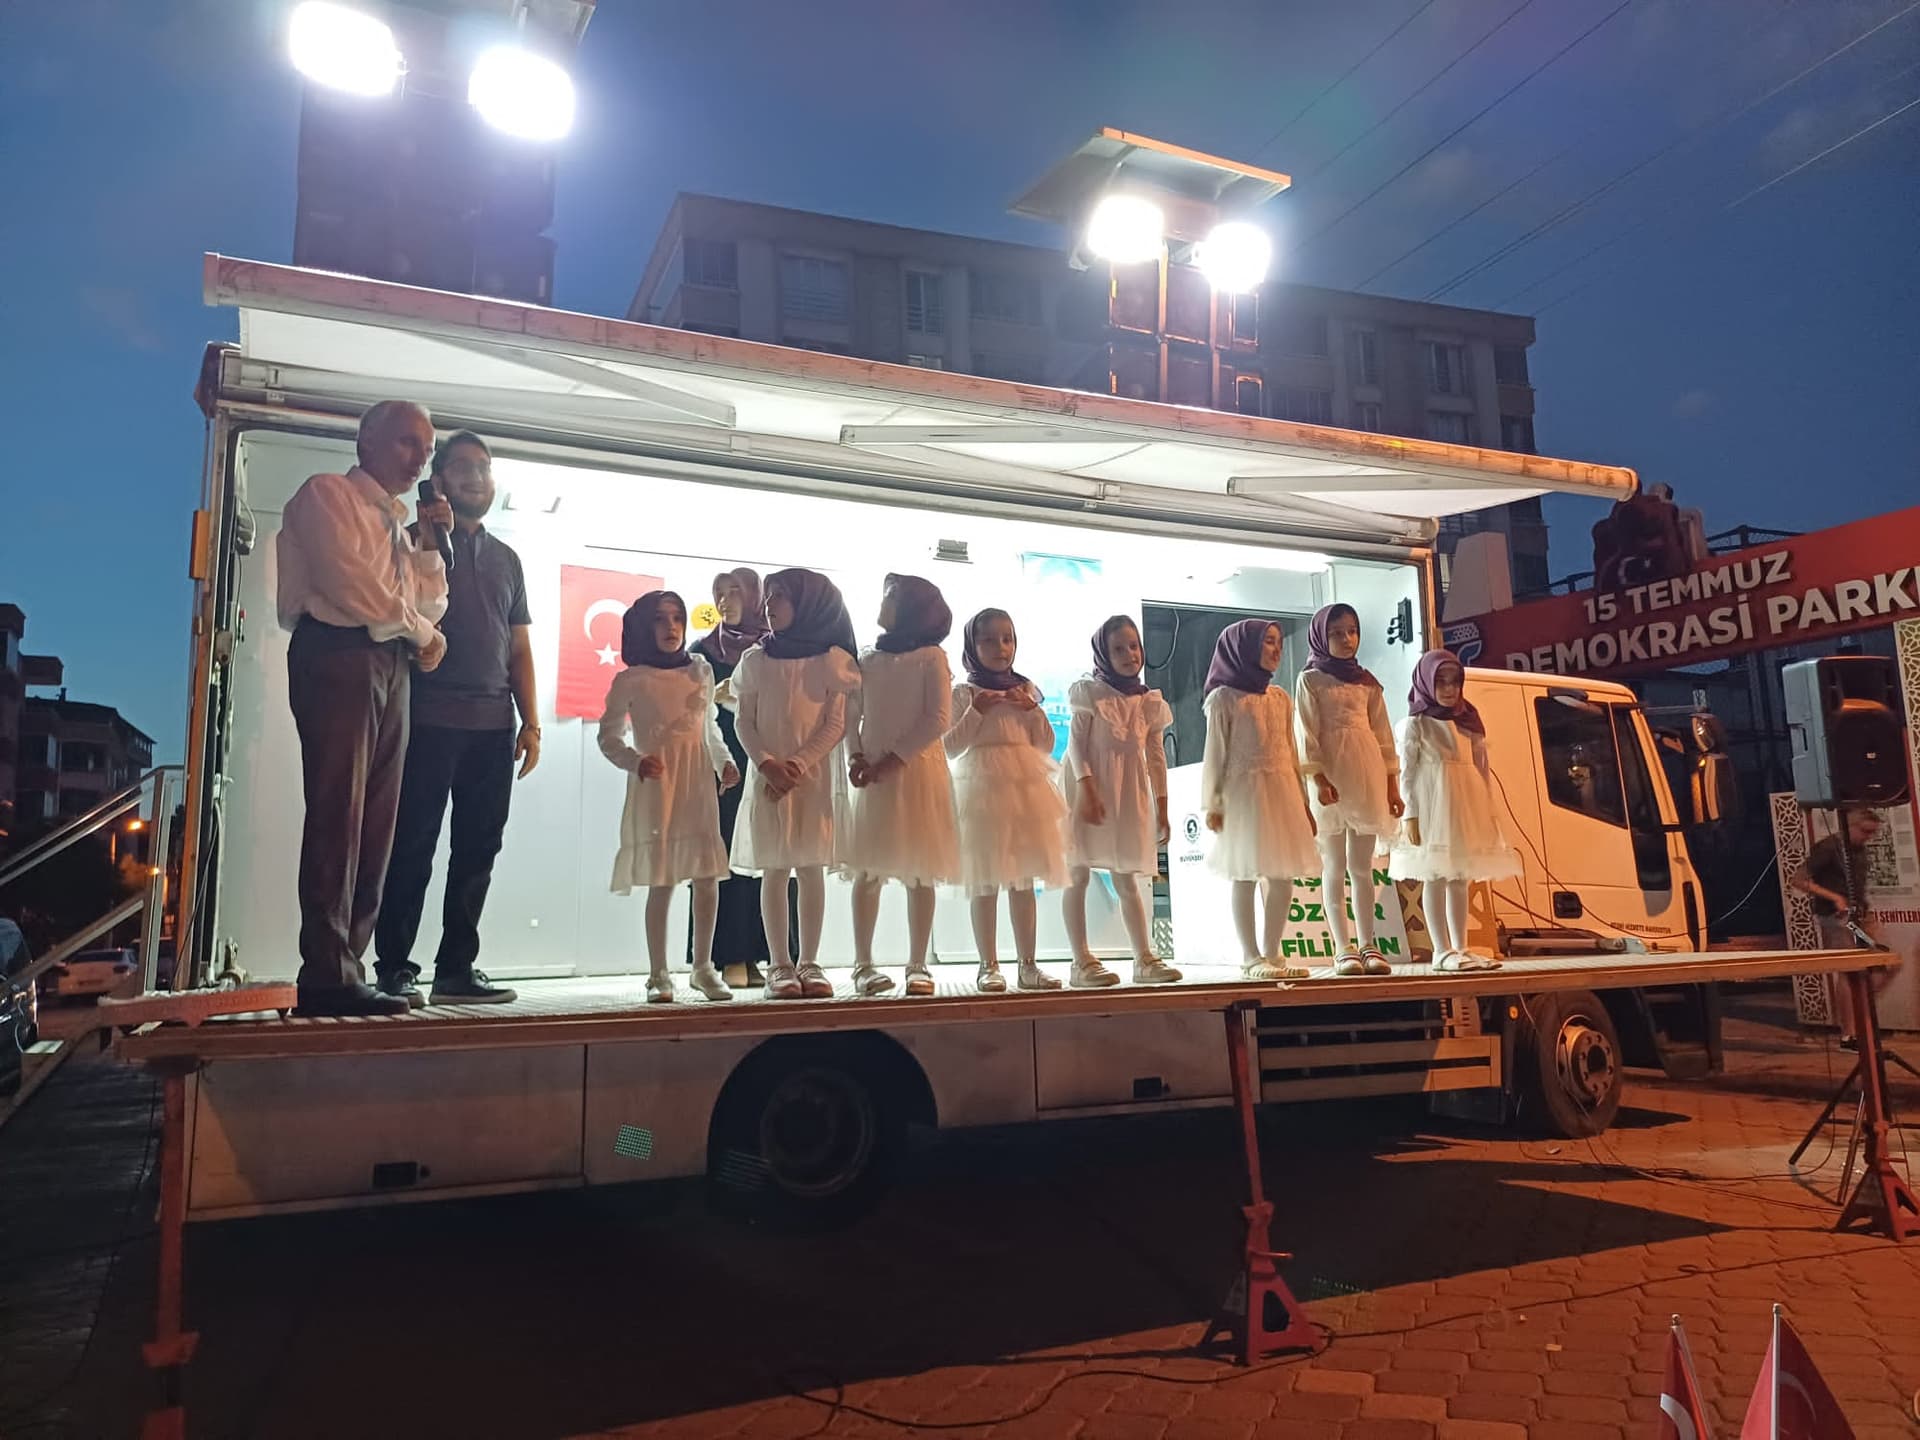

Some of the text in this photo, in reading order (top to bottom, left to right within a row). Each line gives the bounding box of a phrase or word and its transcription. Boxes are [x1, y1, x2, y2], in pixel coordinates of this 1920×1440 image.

[1584, 550, 1791, 624] 15 TEMMUZ
[1506, 594, 1753, 675] DEMOKRASİ
